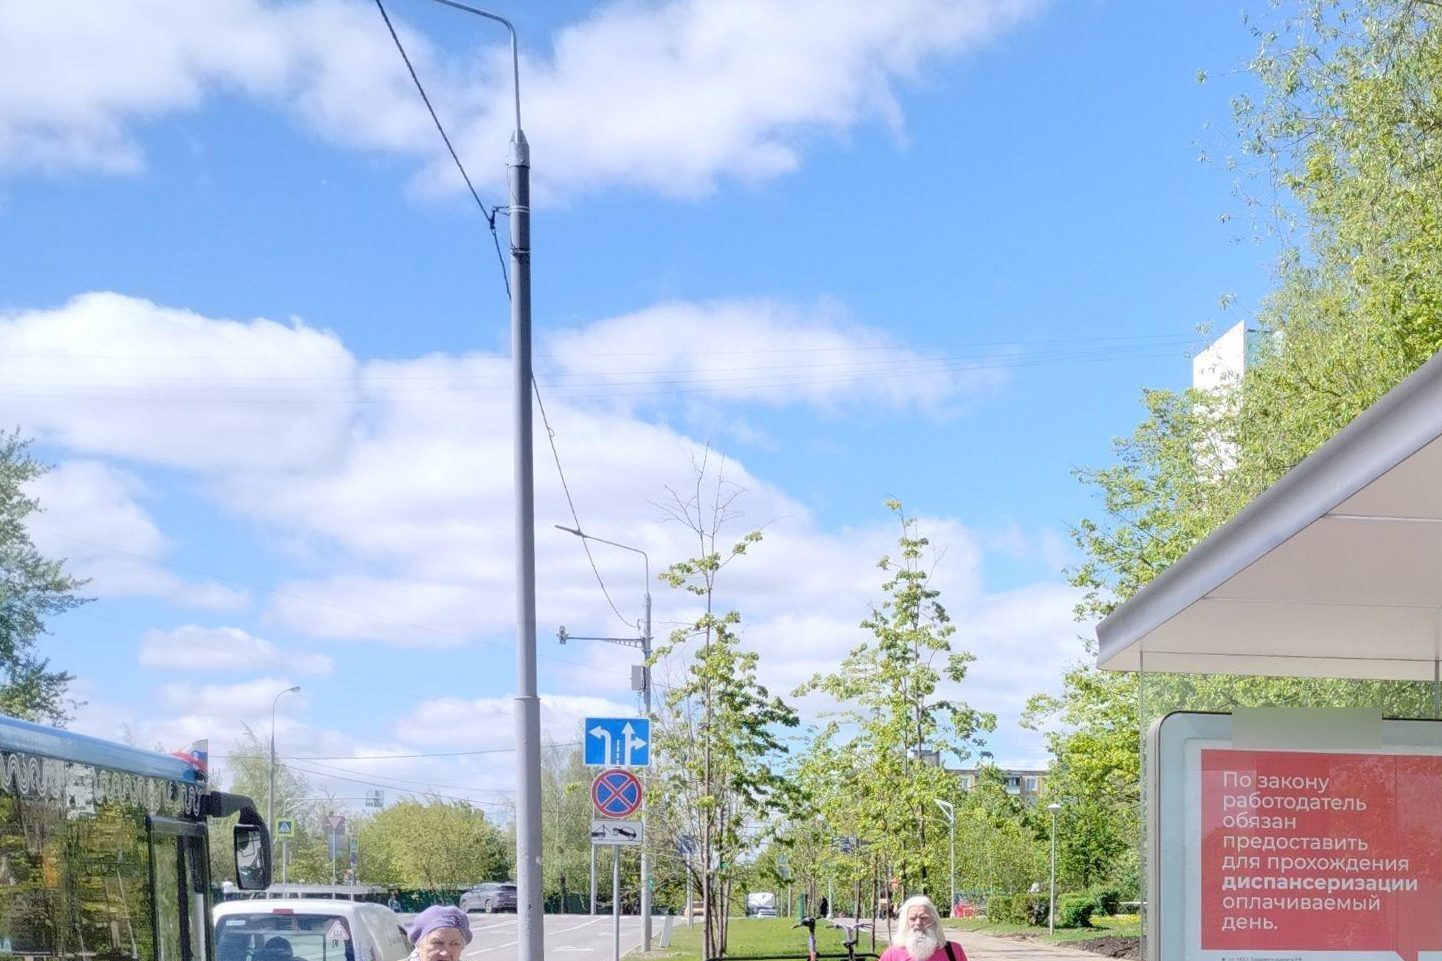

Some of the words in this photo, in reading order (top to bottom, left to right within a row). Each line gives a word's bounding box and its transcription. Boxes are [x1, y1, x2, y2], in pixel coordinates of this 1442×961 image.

[1223, 771, 1251, 789] По
[1258, 775, 1330, 793] закону
[1223, 792, 1367, 814] работодатель
[1222, 812, 1296, 830] обязан
[1222, 836, 1368, 851] предоставить
[1222, 855, 1260, 870] для
[1267, 856, 1409, 873] прохождения
[1222, 875, 1418, 894] диспансеризации
[1222, 894, 1381, 912] оплачиваемый
[1222, 916, 1278, 932] день.
